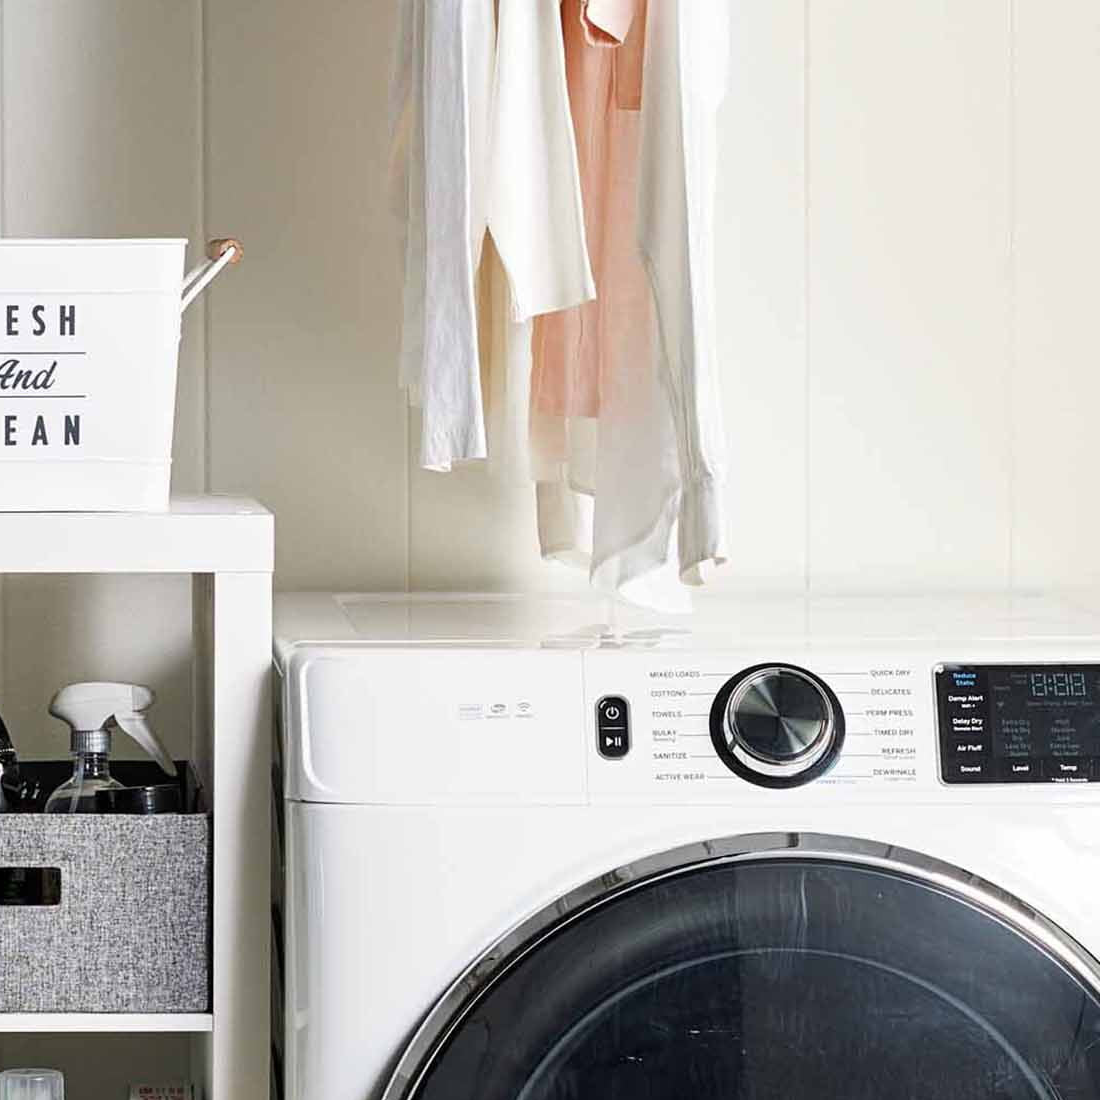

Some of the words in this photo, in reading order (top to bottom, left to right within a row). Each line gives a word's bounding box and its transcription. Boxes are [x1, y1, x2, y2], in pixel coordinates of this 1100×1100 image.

[870, 688, 912, 696] DELICATES
[948, 695, 968, 703] Damp
[952, 718, 971, 726] Delay
[971, 718, 983, 726] Dry
[652, 752, 688, 760] SANITIZE
[960, 765, 981, 773] Sound
